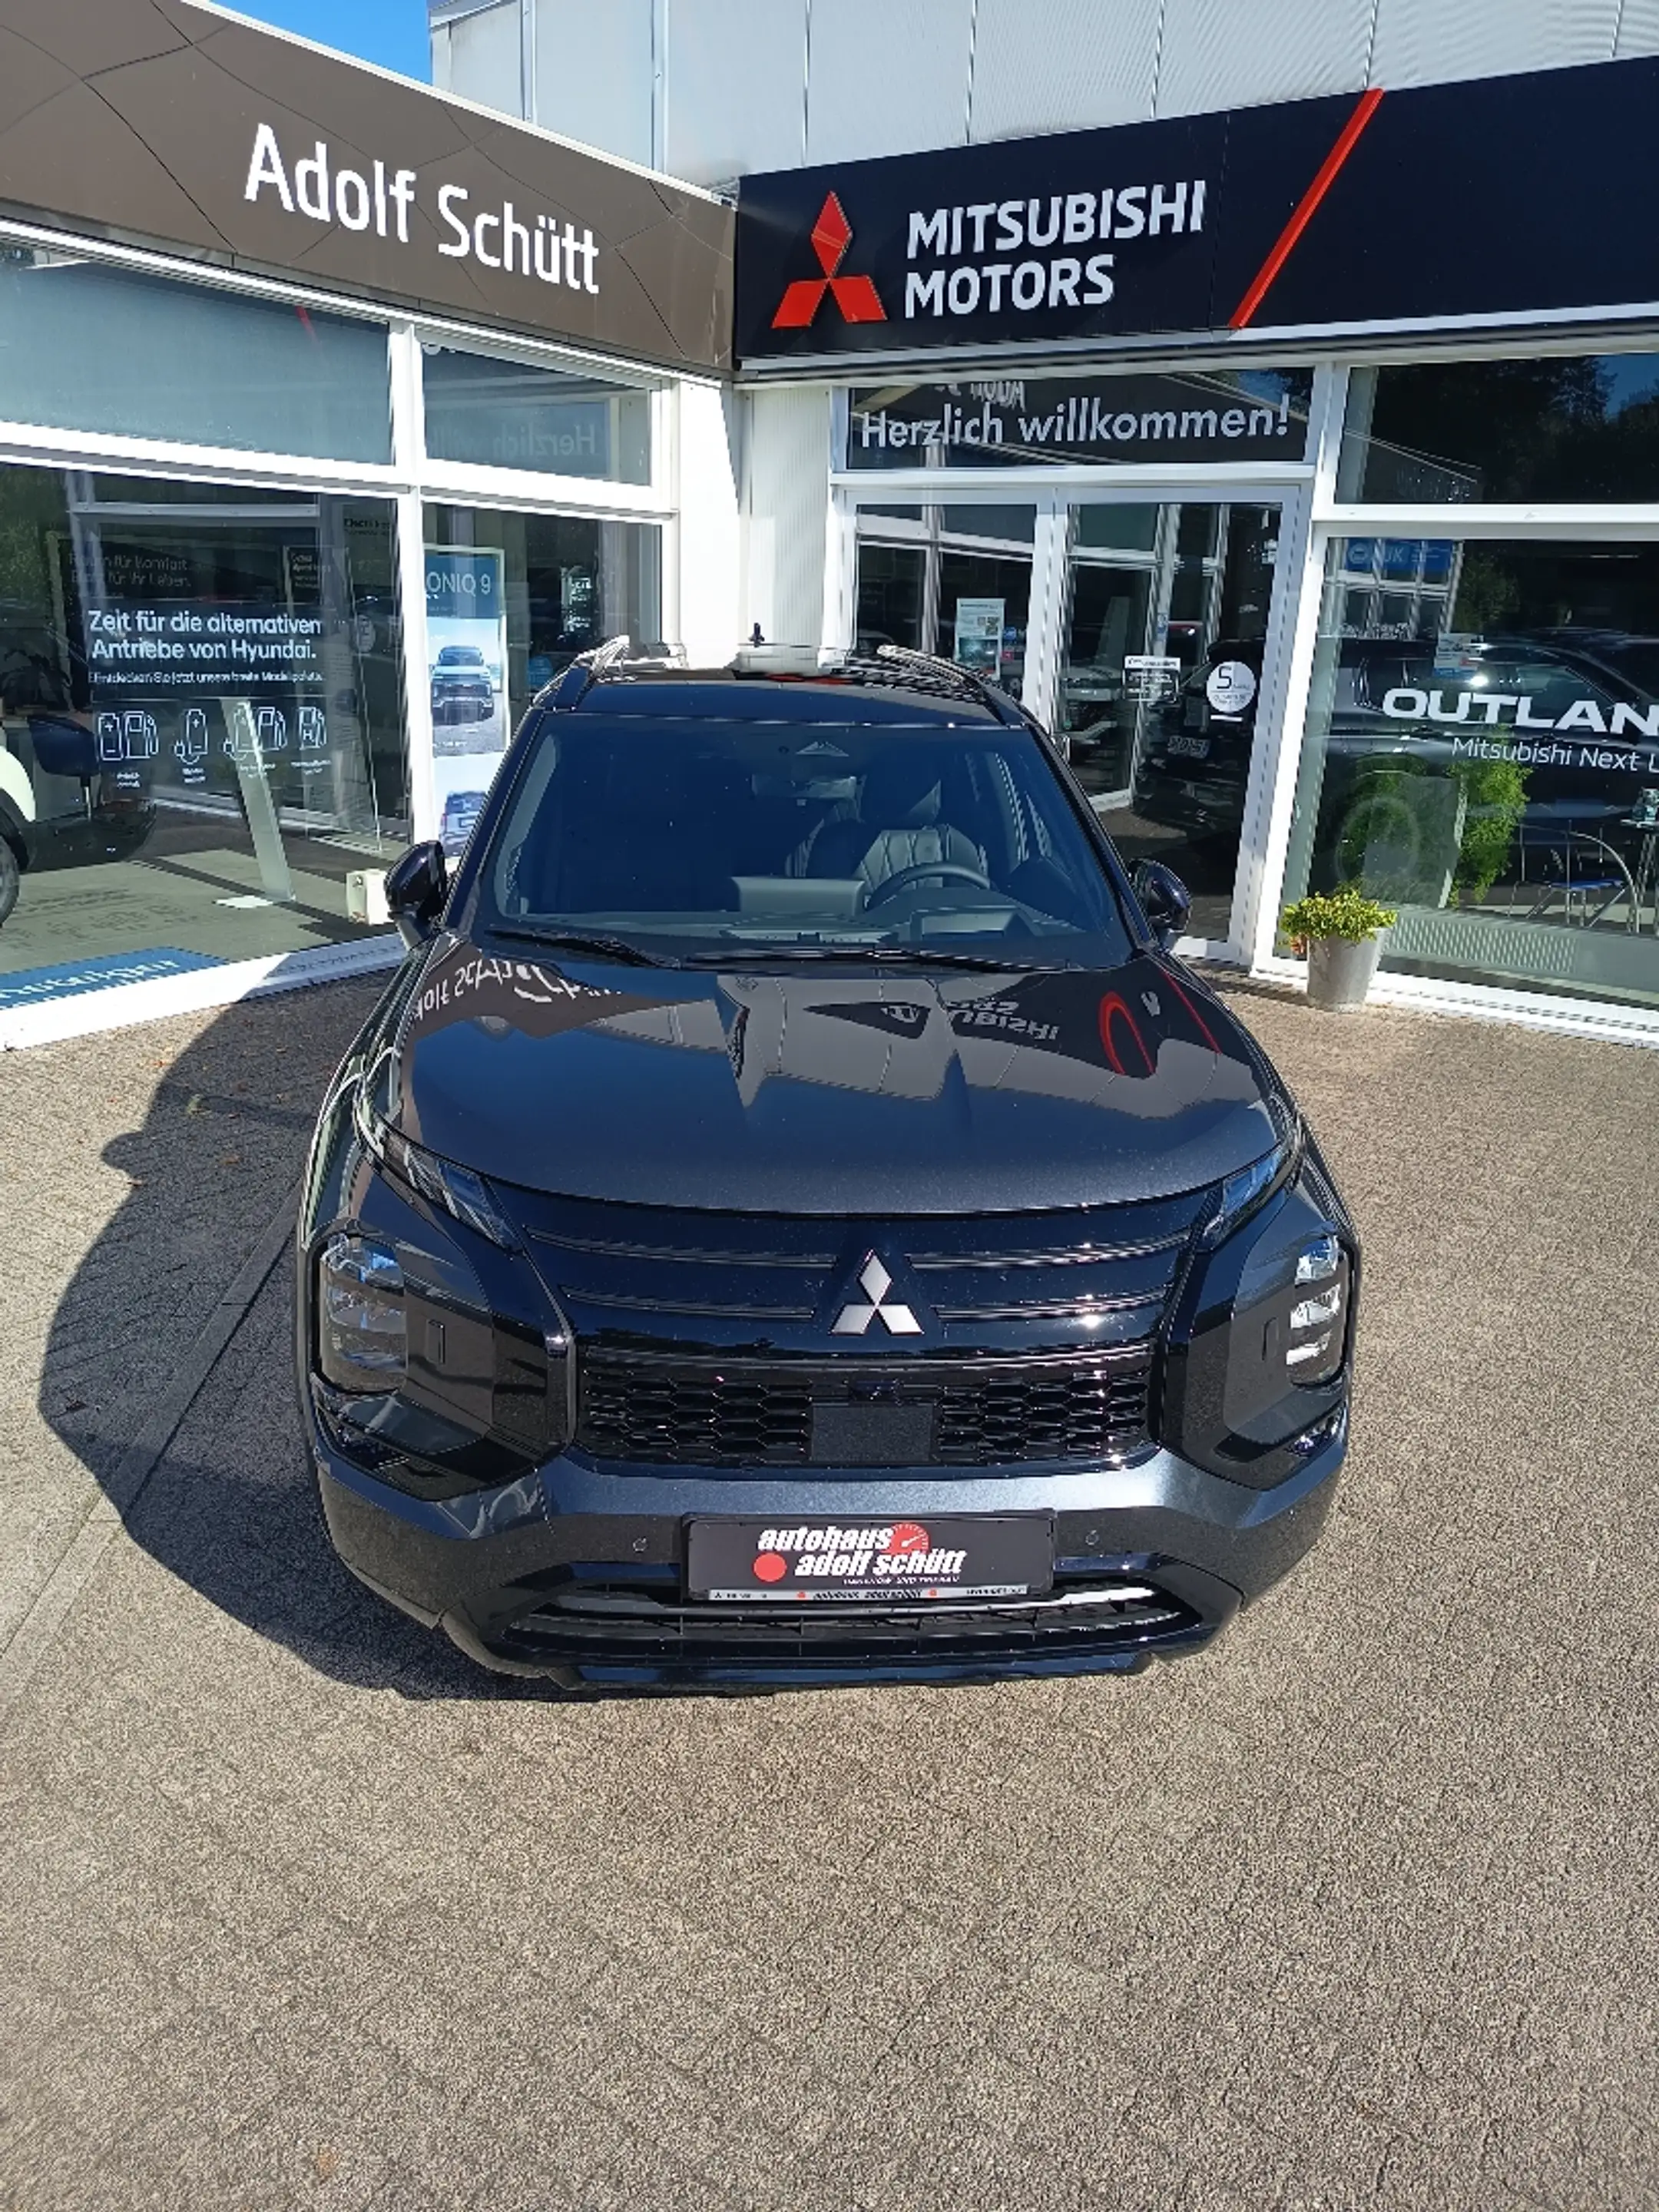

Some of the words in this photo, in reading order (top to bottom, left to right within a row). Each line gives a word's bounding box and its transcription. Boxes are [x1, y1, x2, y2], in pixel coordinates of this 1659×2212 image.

[244, 123, 416, 243] Adolf
[438, 185, 600, 293] Schütt
[907, 180, 1207, 259] MITSUBISHI
[905, 254, 1115, 318] MOTORS
[862, 402, 1004, 448] Herzlich
[1018, 393, 1290, 442] willkommen!
[481, 575, 492, 594] 9
[88, 610, 131, 632] Zeit
[136, 611, 167, 632] für
[171, 611, 202, 632] die
[207, 612, 323, 634] alternativen
[92, 638, 184, 659] Antriebe
[190, 642, 227, 659] von
[232, 639, 316, 663] Hyundai.
[1382, 688, 1659, 737] OUTLAN
[1452, 737, 1572, 766] Mitsubishi
[1579, 747, 1641, 772] Next
[757, 1525, 894, 1551] autohaus
[794, 1549, 875, 1576] adolf
[871, 1548, 967, 1575] schütt
